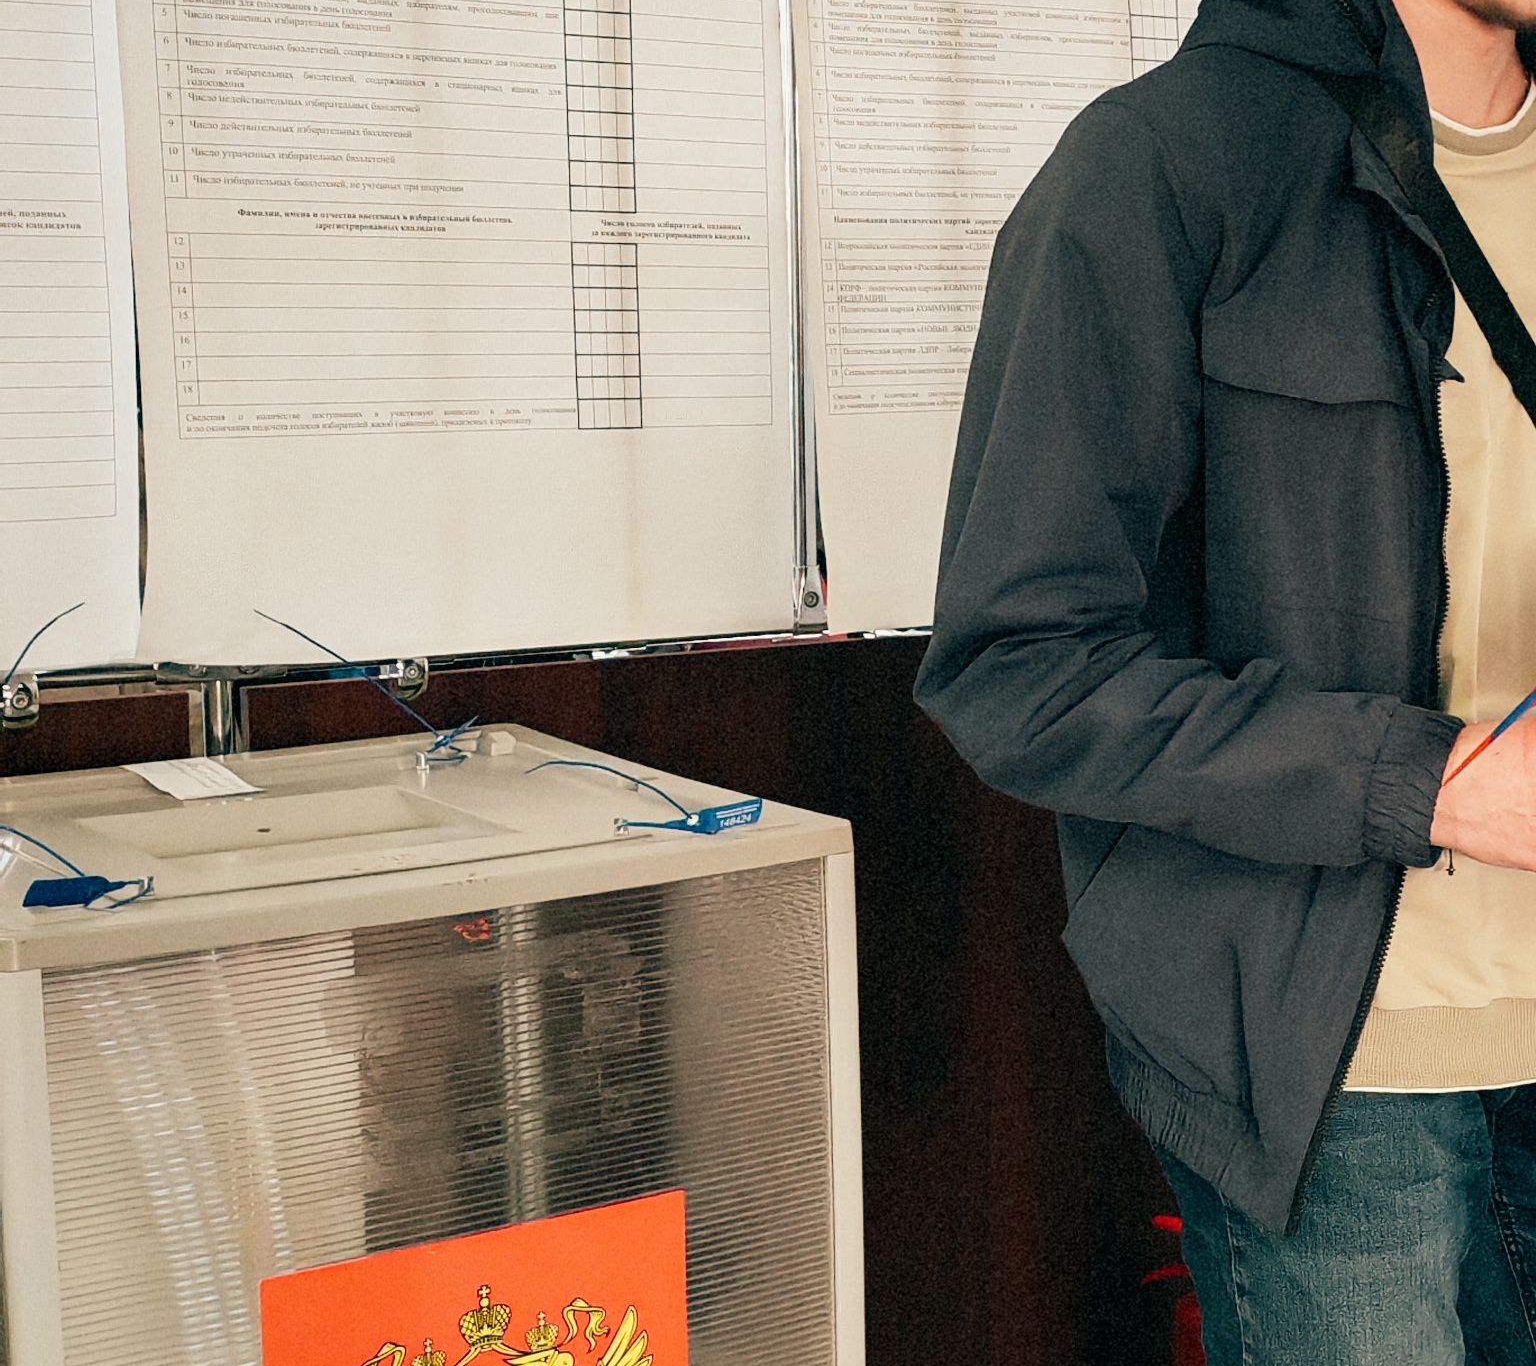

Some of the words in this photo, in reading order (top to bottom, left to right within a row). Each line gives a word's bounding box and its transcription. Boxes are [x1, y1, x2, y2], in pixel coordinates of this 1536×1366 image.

[174, 236, 184, 246] 12
[175, 261, 185, 270] 13
[177, 286, 187, 295] 14
[178, 311, 189, 320] 15
[180, 336, 190, 345] 16
[181, 360, 191, 370] 17
[183, 385, 194, 394] 18
